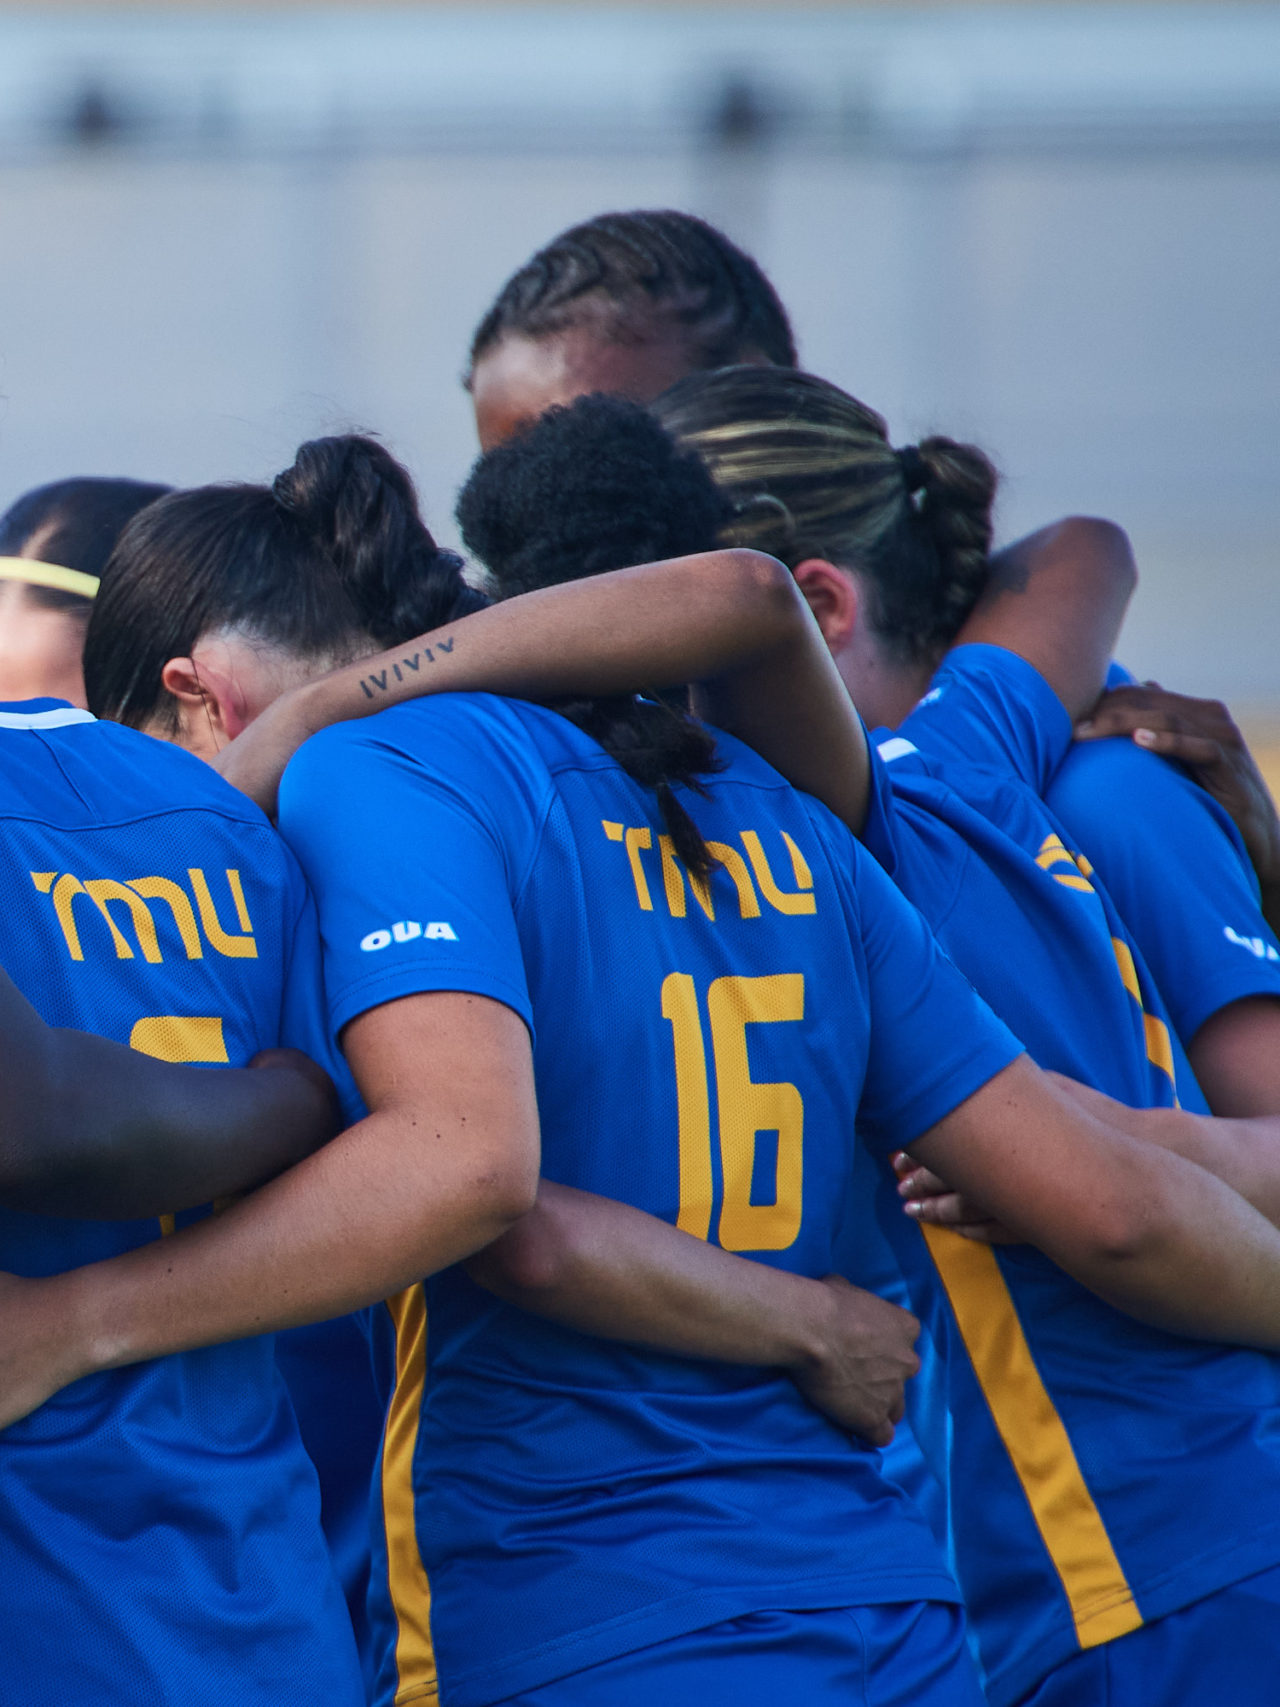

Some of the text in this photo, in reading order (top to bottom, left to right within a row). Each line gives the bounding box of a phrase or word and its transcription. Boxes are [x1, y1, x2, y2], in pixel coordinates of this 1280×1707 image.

[30, 868, 258, 963] TMU
[602, 820, 817, 922] TMU
[360, 920, 460, 952] OUA
[661, 972, 804, 1252] 16
